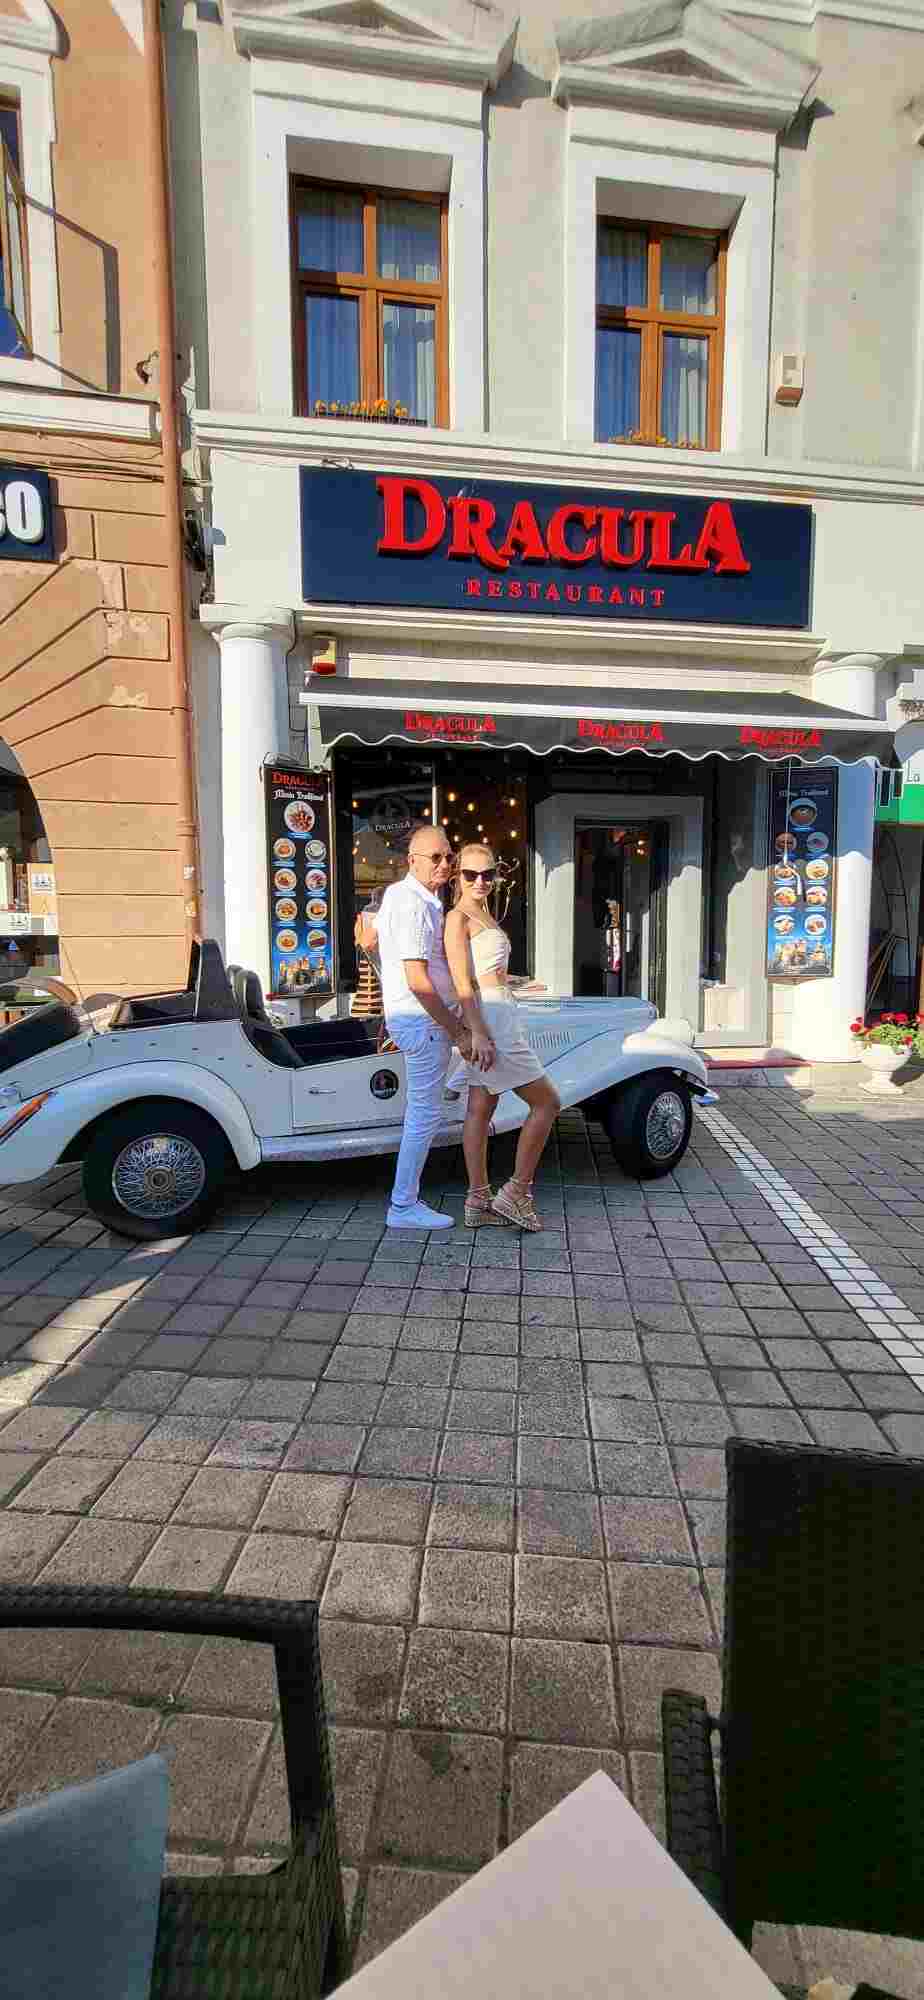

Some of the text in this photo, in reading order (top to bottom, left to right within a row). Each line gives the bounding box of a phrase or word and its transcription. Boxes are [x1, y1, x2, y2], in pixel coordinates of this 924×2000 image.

[375, 475, 751, 576] DRACULA
[466, 577, 665, 607] RESTAURANT
[404, 711, 497, 734] DRACULA
[577, 719, 664, 741] DRACULA
[272, 771, 324, 785] DRACU
